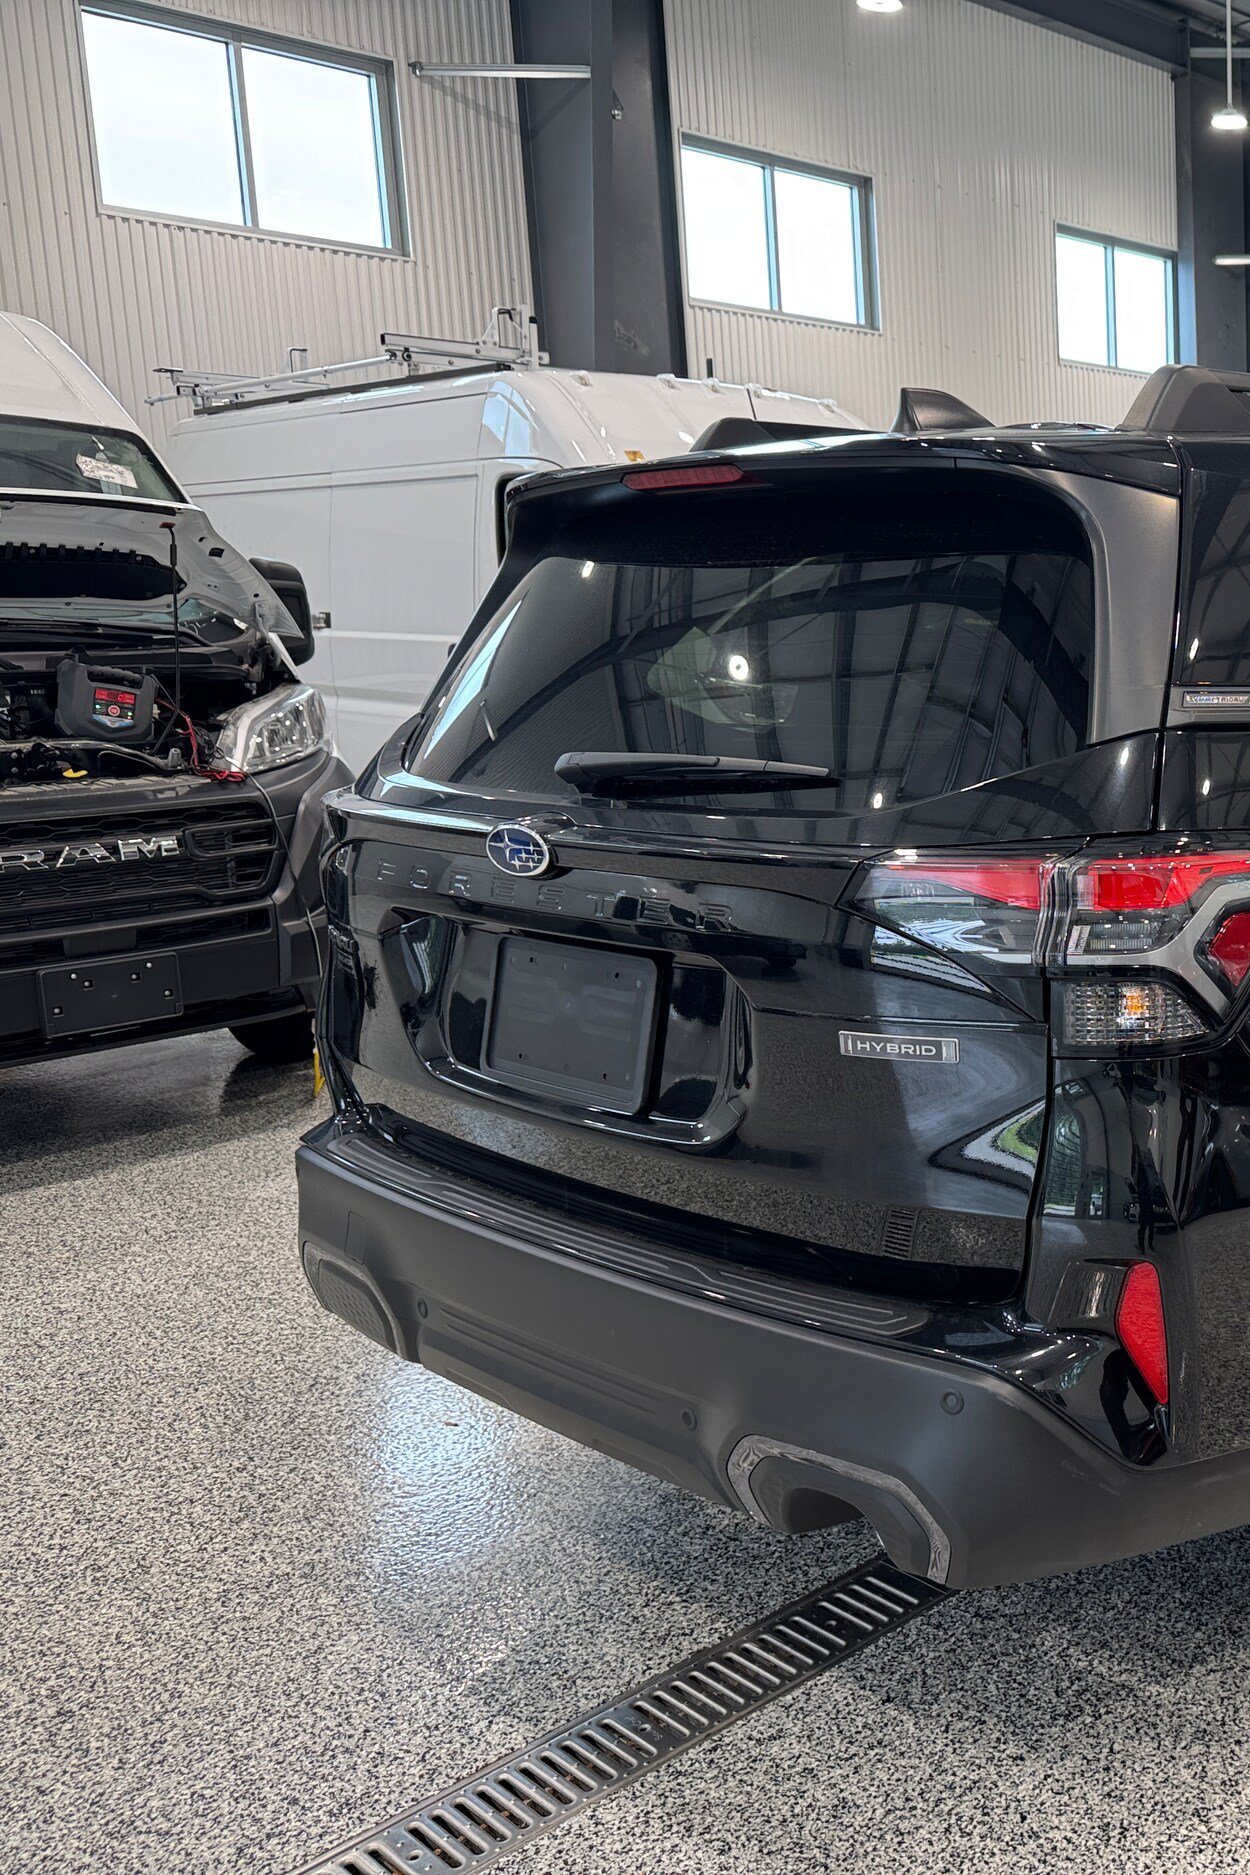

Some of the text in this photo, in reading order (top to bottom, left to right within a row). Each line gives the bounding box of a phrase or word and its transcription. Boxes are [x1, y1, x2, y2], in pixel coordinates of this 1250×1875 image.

[0, 836, 180, 873] RAM
[377, 858, 733, 932] FORESTER
[857, 1040, 937, 1056] HYBRID
